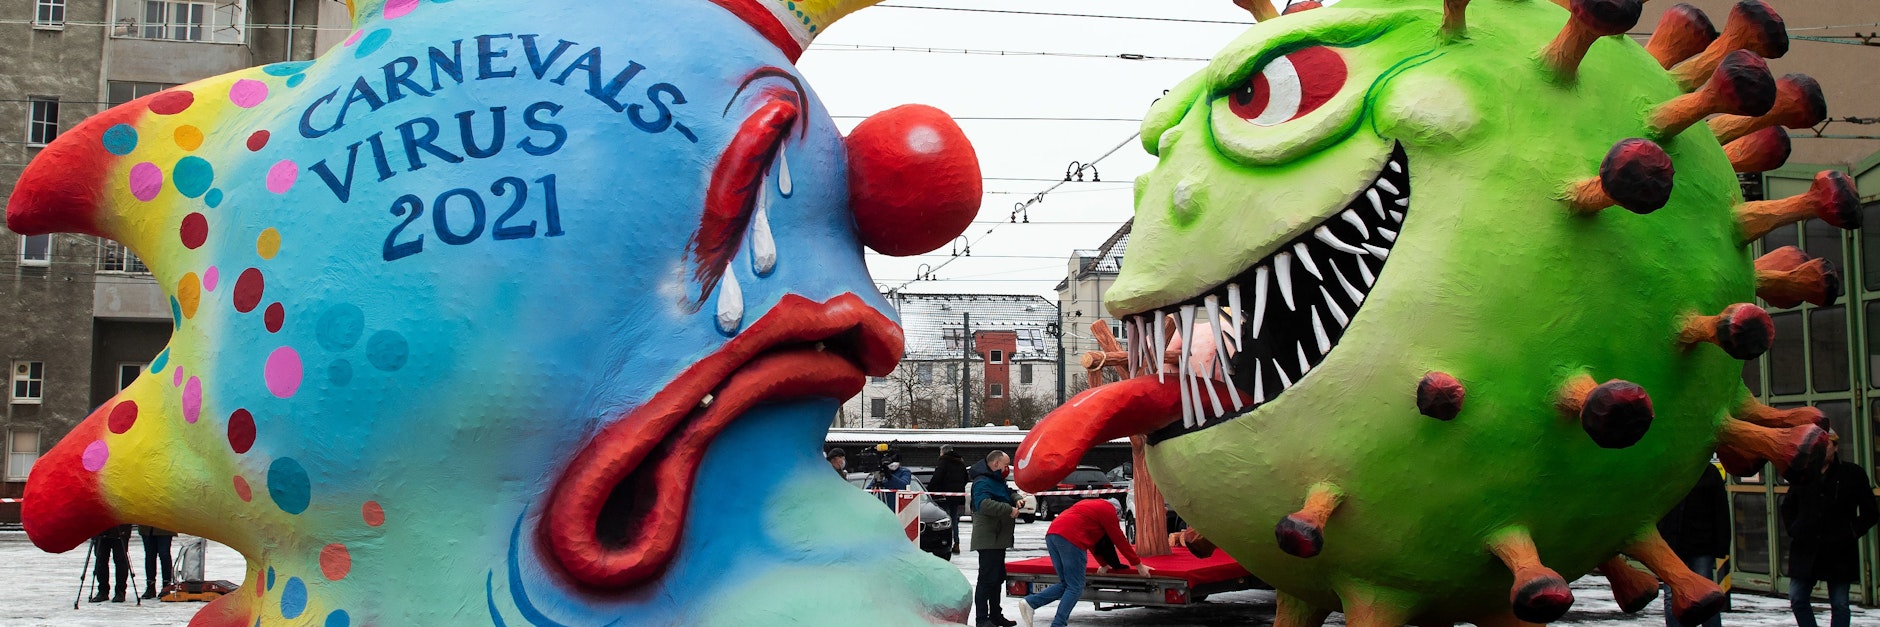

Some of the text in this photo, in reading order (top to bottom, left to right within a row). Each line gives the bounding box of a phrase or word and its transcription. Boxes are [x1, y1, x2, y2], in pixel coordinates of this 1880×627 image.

[299, 33, 699, 143] CARNEVALS-
[308, 101, 568, 203] VIRUS
[383, 174, 566, 261] 2021
